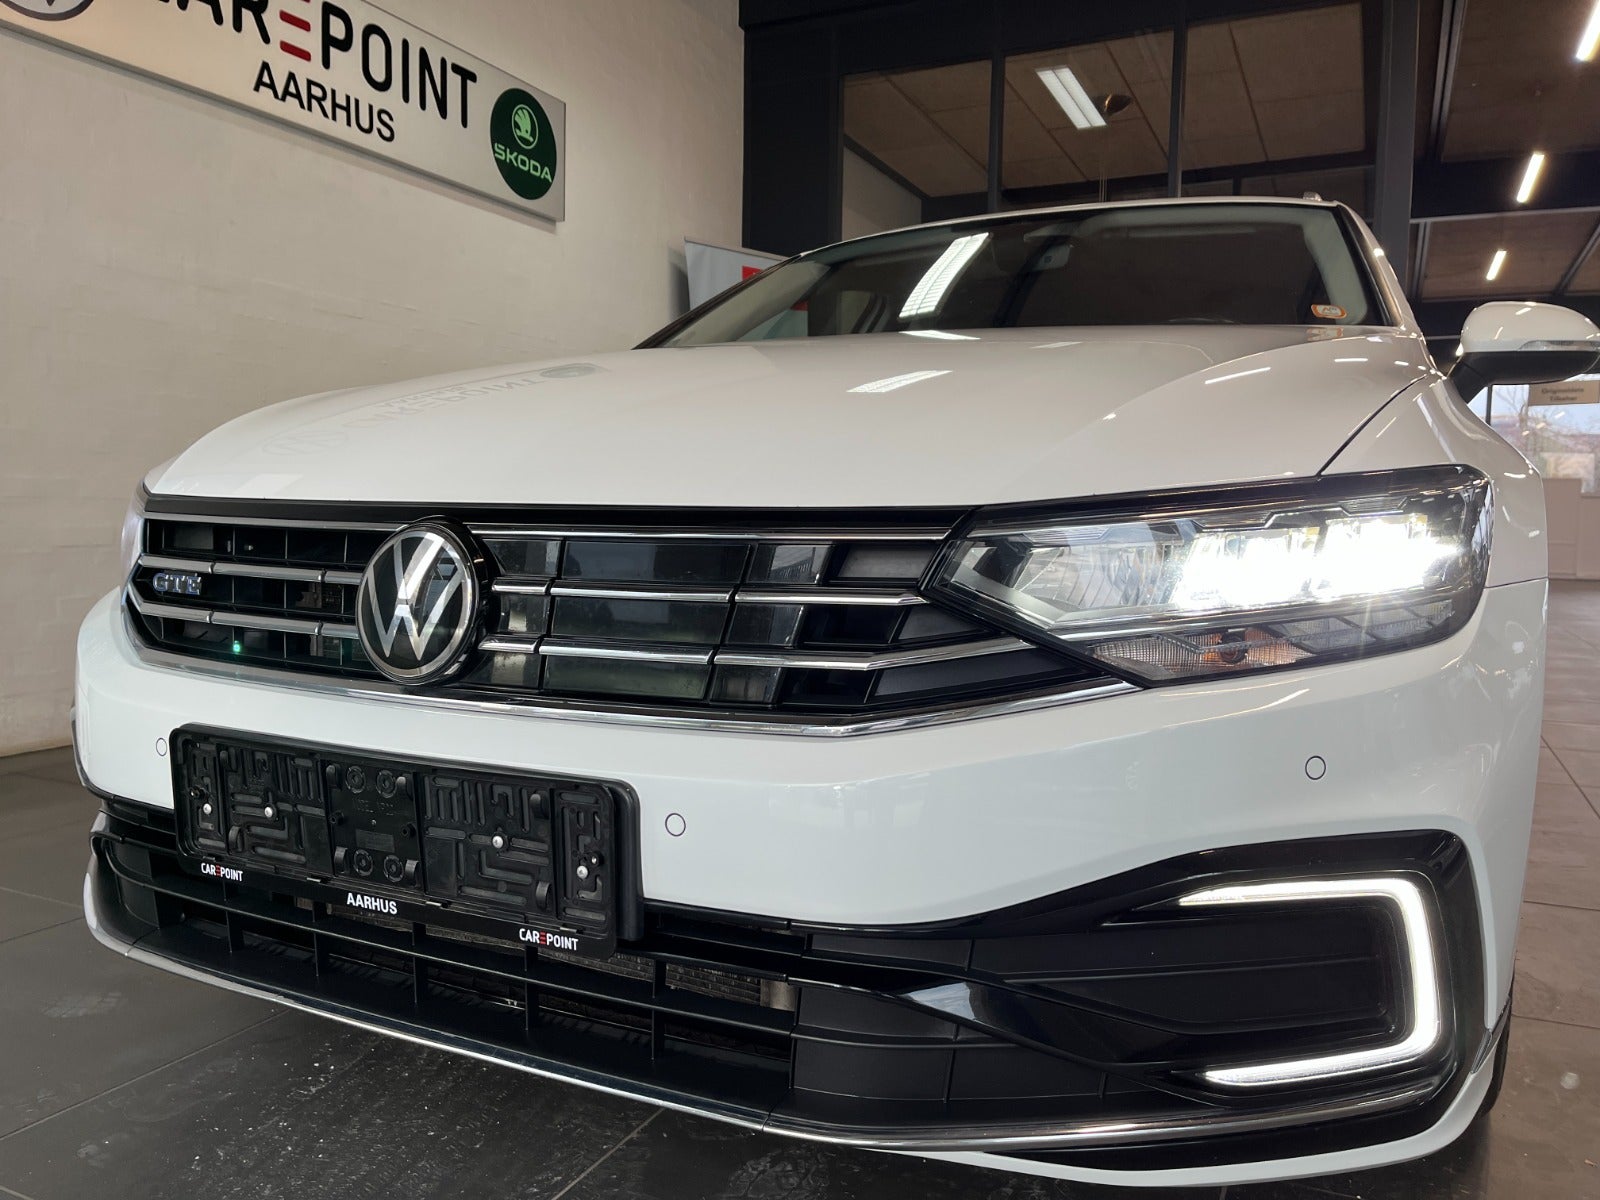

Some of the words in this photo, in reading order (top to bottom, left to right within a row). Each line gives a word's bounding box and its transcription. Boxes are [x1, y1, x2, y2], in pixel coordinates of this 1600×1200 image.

[158, 0, 478, 129] REPOINT
[253, 60, 395, 142] AARHUS
[153, 572, 201, 595] GTE
[200, 862, 243, 882] CAREPOINT
[346, 892, 398, 915] AARHUS
[518, 927, 579, 951] CAREPOINT
